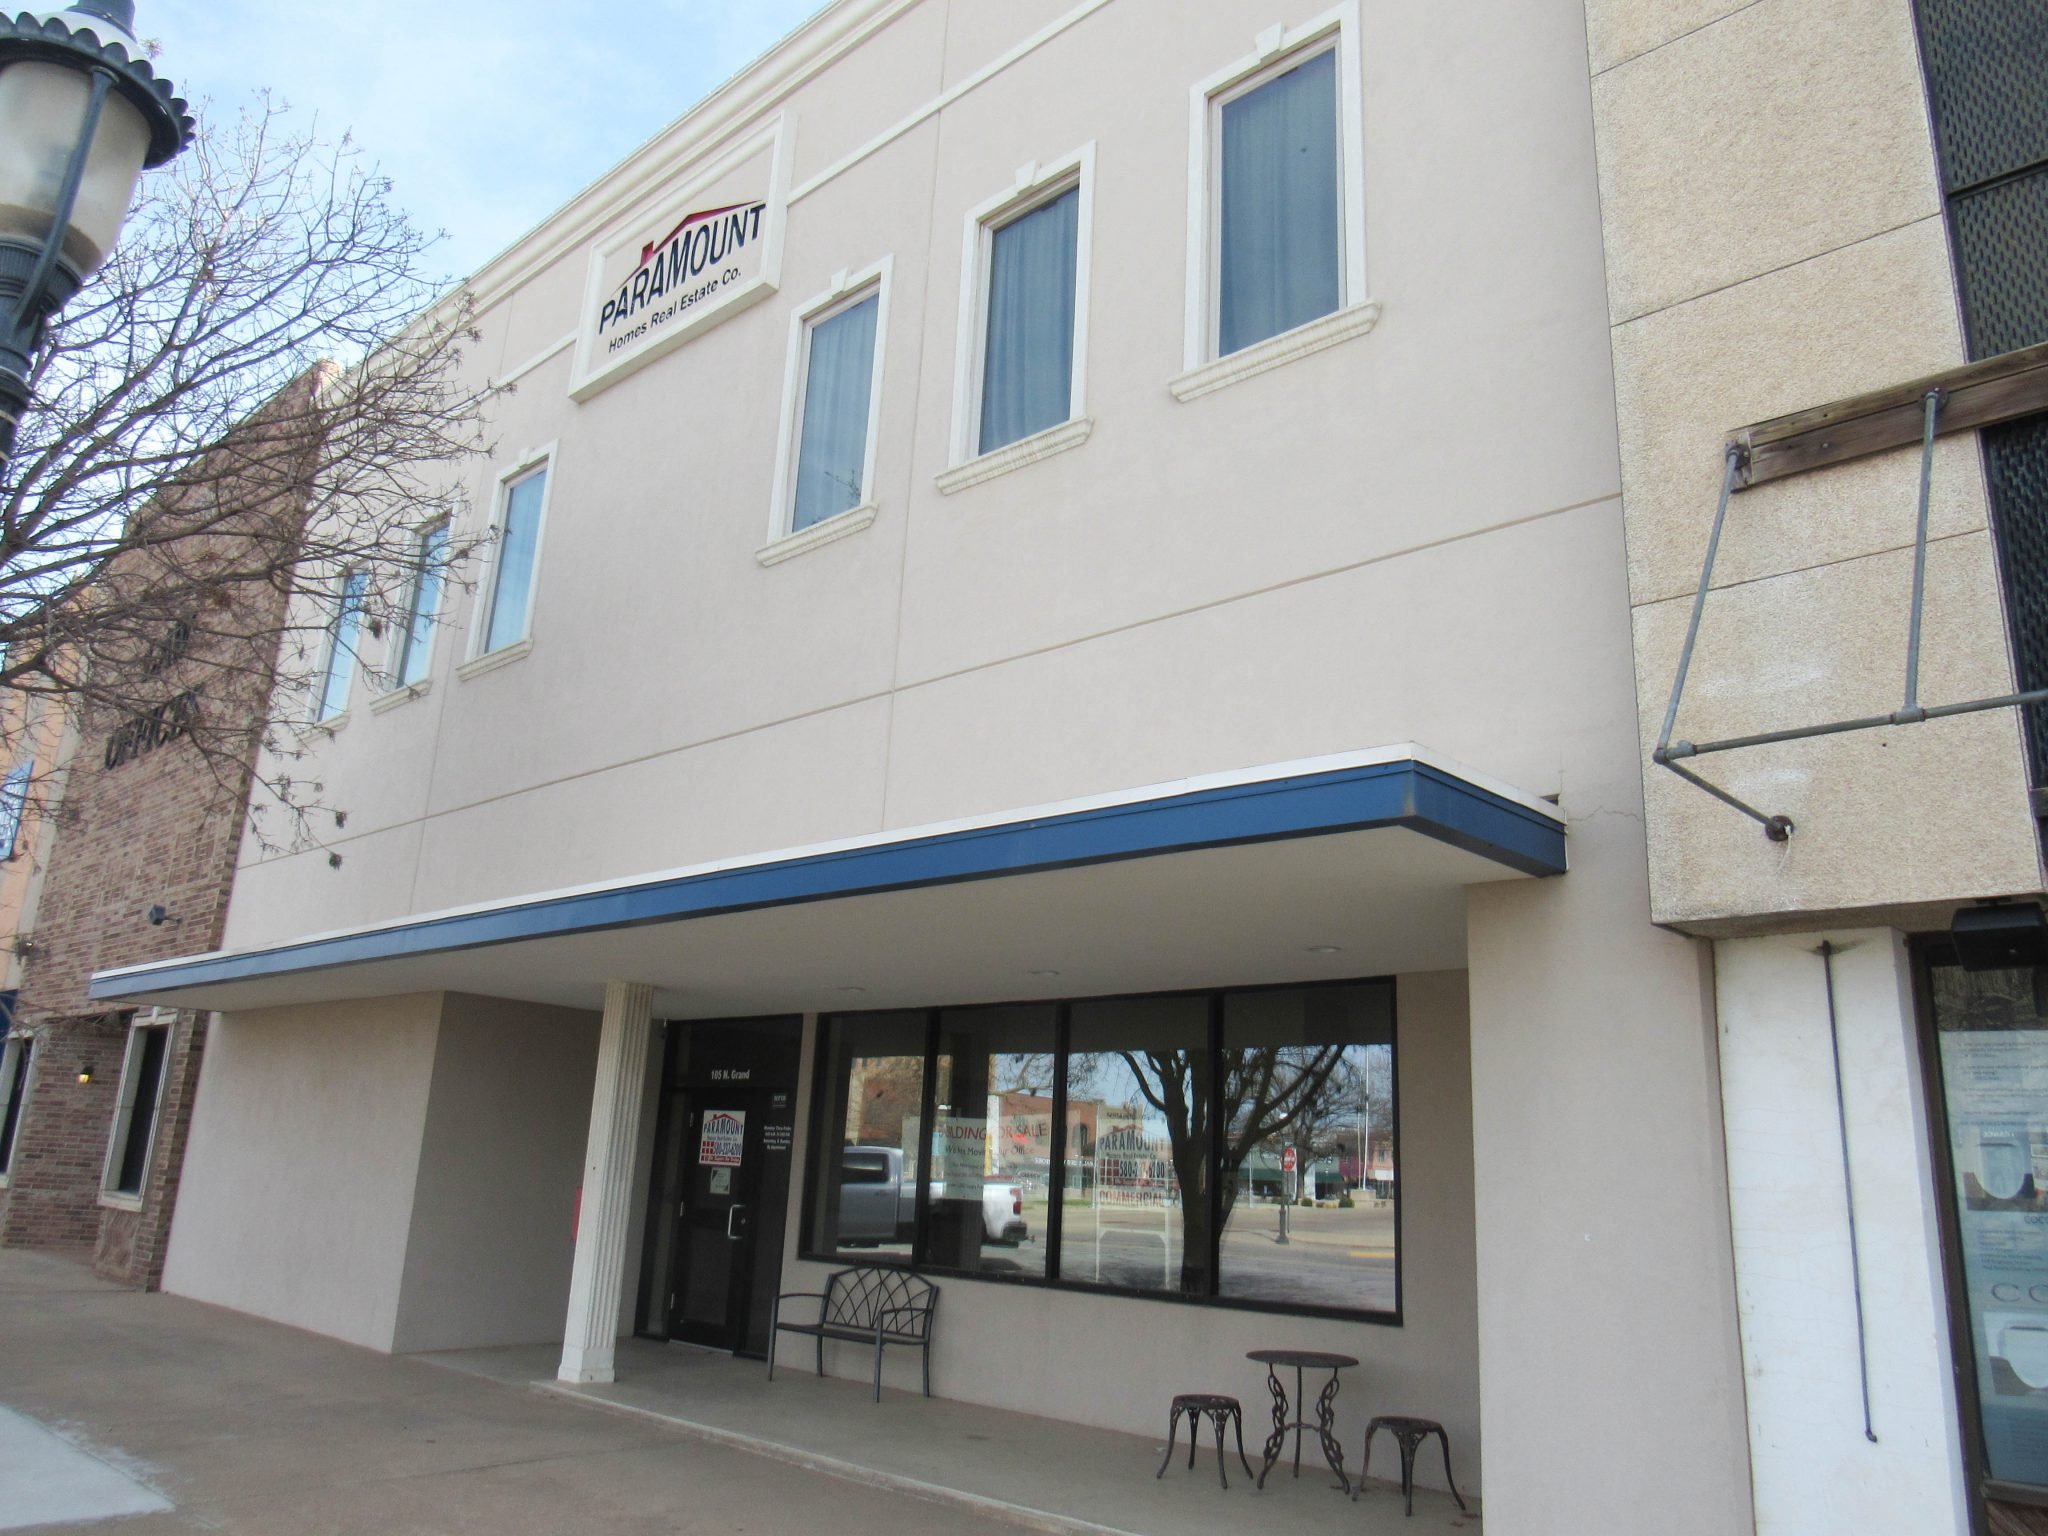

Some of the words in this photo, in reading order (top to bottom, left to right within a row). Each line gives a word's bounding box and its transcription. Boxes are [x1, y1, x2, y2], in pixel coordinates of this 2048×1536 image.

[599, 203, 766, 335] PARAMOUNT
[608, 322, 647, 353] Homes
[651, 301, 677, 329] Real
[680, 279, 718, 310] Estate
[722, 267, 742, 285] Co.
[711, 1070, 722, 1080] 105
[722, 1070, 730, 1080] N.
[731, 1069, 750, 1080] Grand
[703, 1118, 744, 1135] PARAMOUNT
[1016, 1122, 1048, 1137] SALE
[1099, 1129, 1165, 1151] PARAMOUNT
